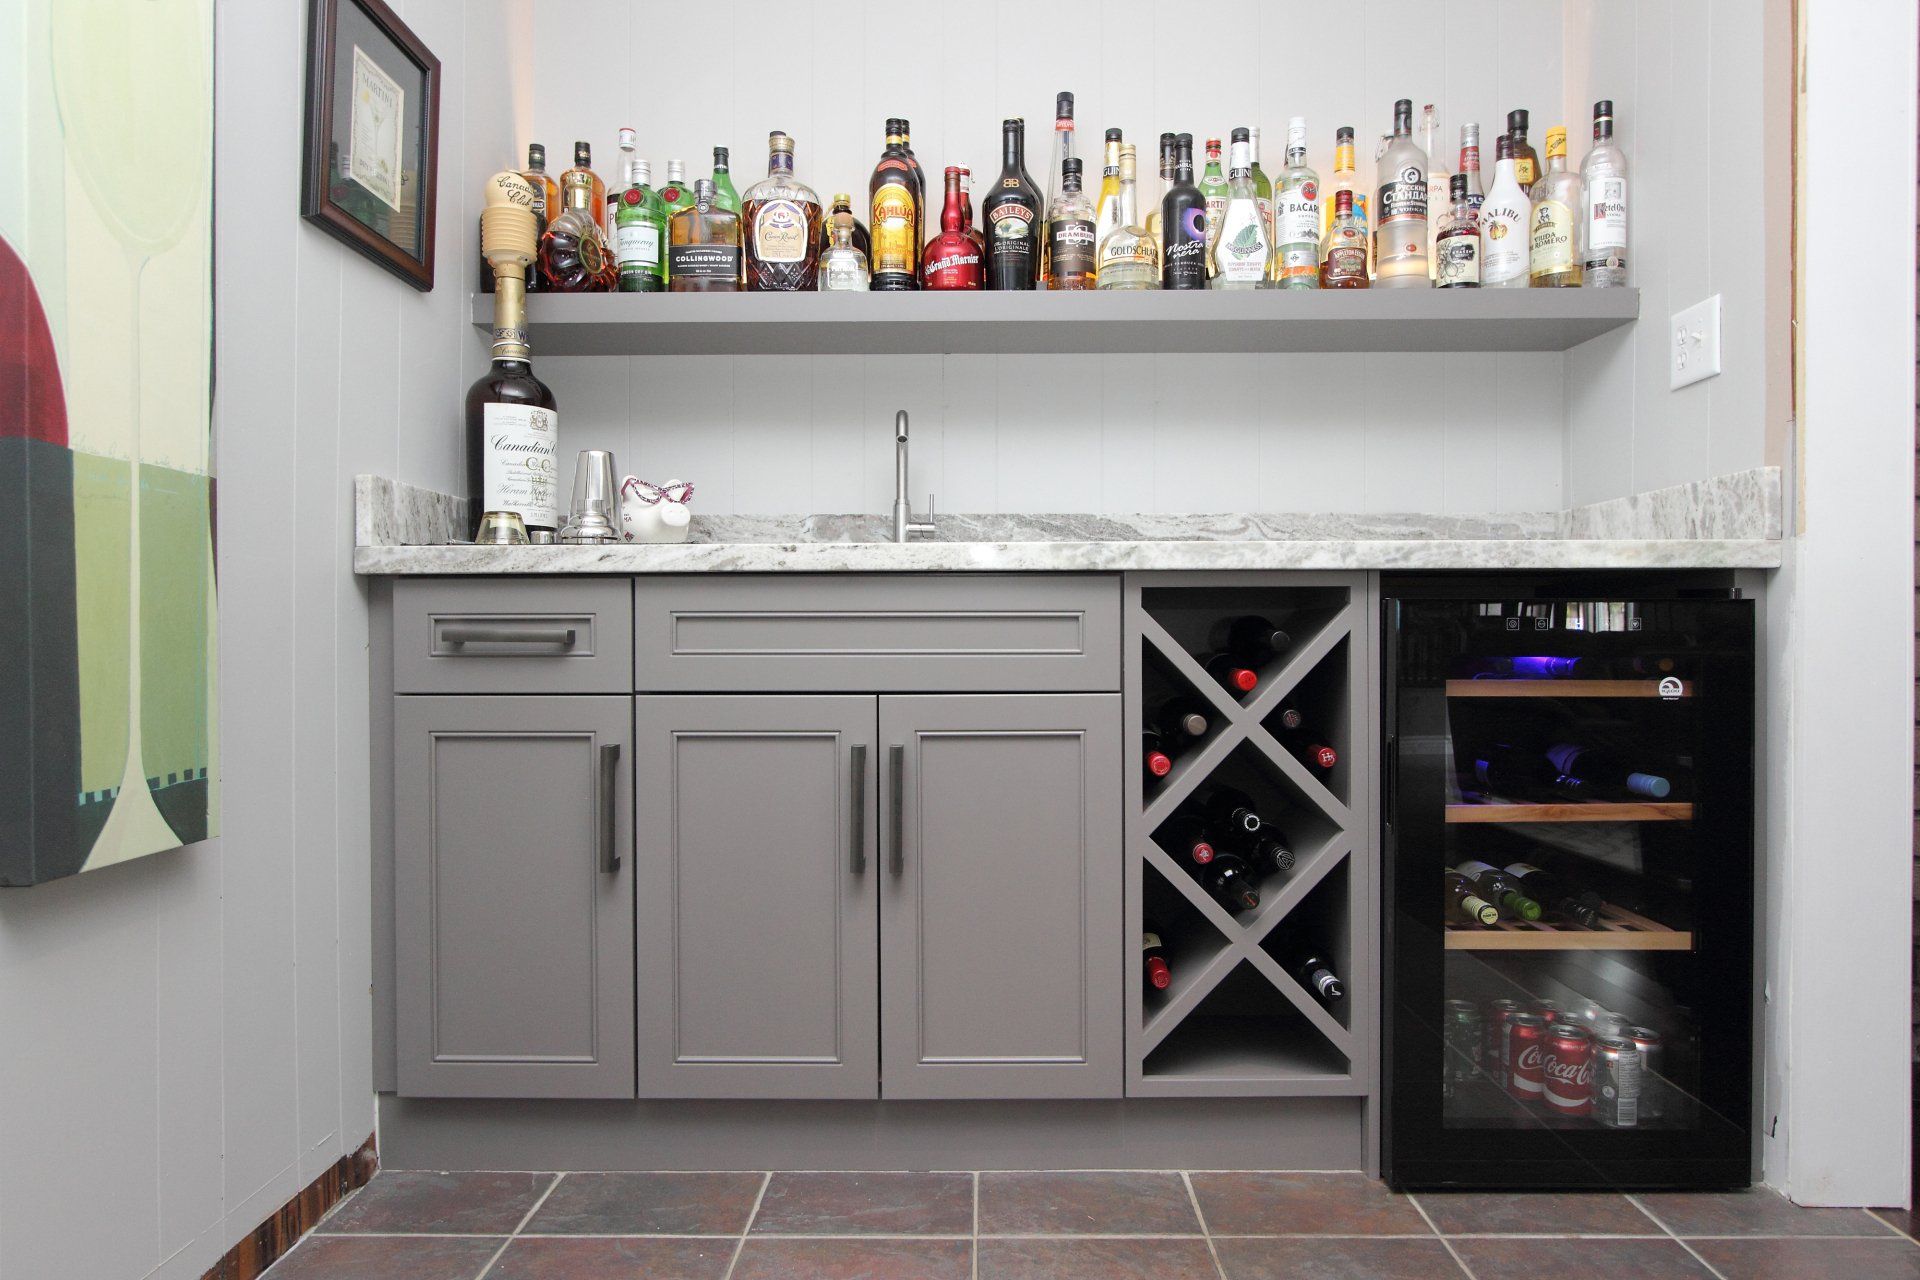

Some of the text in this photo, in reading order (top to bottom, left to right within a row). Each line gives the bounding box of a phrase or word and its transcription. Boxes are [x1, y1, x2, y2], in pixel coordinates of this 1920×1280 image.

[1205, 200, 1224, 209] ARTI
[1467, 196, 1483, 205] OLS
[992, 205, 1032, 220] BAILEYS
[1290, 203, 1319, 214] BACAR
[1482, 208, 1521, 226] MALIBU
[1058, 232, 1093, 240] DRAMBUIE
[490, 433, 549, 456] Canadian
